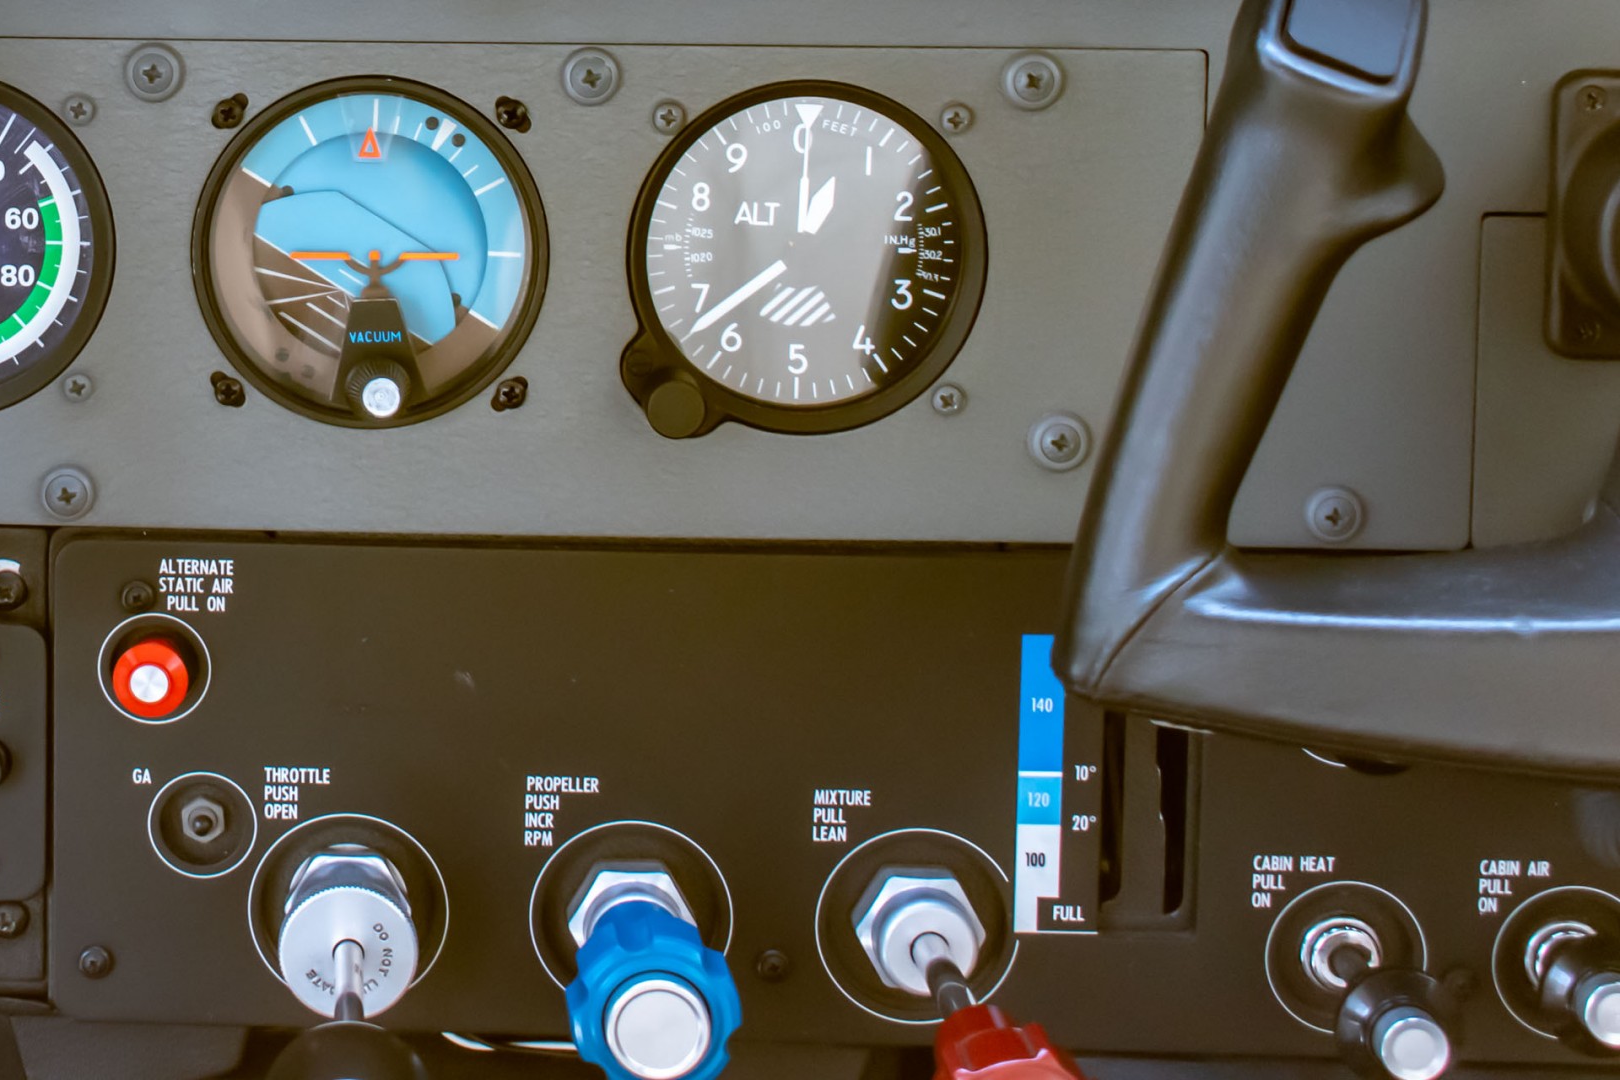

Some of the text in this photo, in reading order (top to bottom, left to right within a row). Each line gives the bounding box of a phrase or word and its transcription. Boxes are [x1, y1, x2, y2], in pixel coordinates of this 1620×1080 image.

[822, 122, 858, 136] FEET
[734, 202, 780, 225] ALT
[349, 331, 401, 343] VACUUM
[788, 344, 808, 374] 5
[159, 559, 233, 576] ALTERNATE
[159, 577, 233, 594] STATIC AIR
[167, 595, 225, 611] PULL ON
[265, 767, 330, 785] THROTTLE
[526, 776, 599, 793] PROPELLER
[814, 789, 871, 807] MIXTURE
[1027, 791, 1050, 808] 120
[1254, 855, 1335, 873] CABIN HEAT
[1053, 904, 1084, 922] FULL
